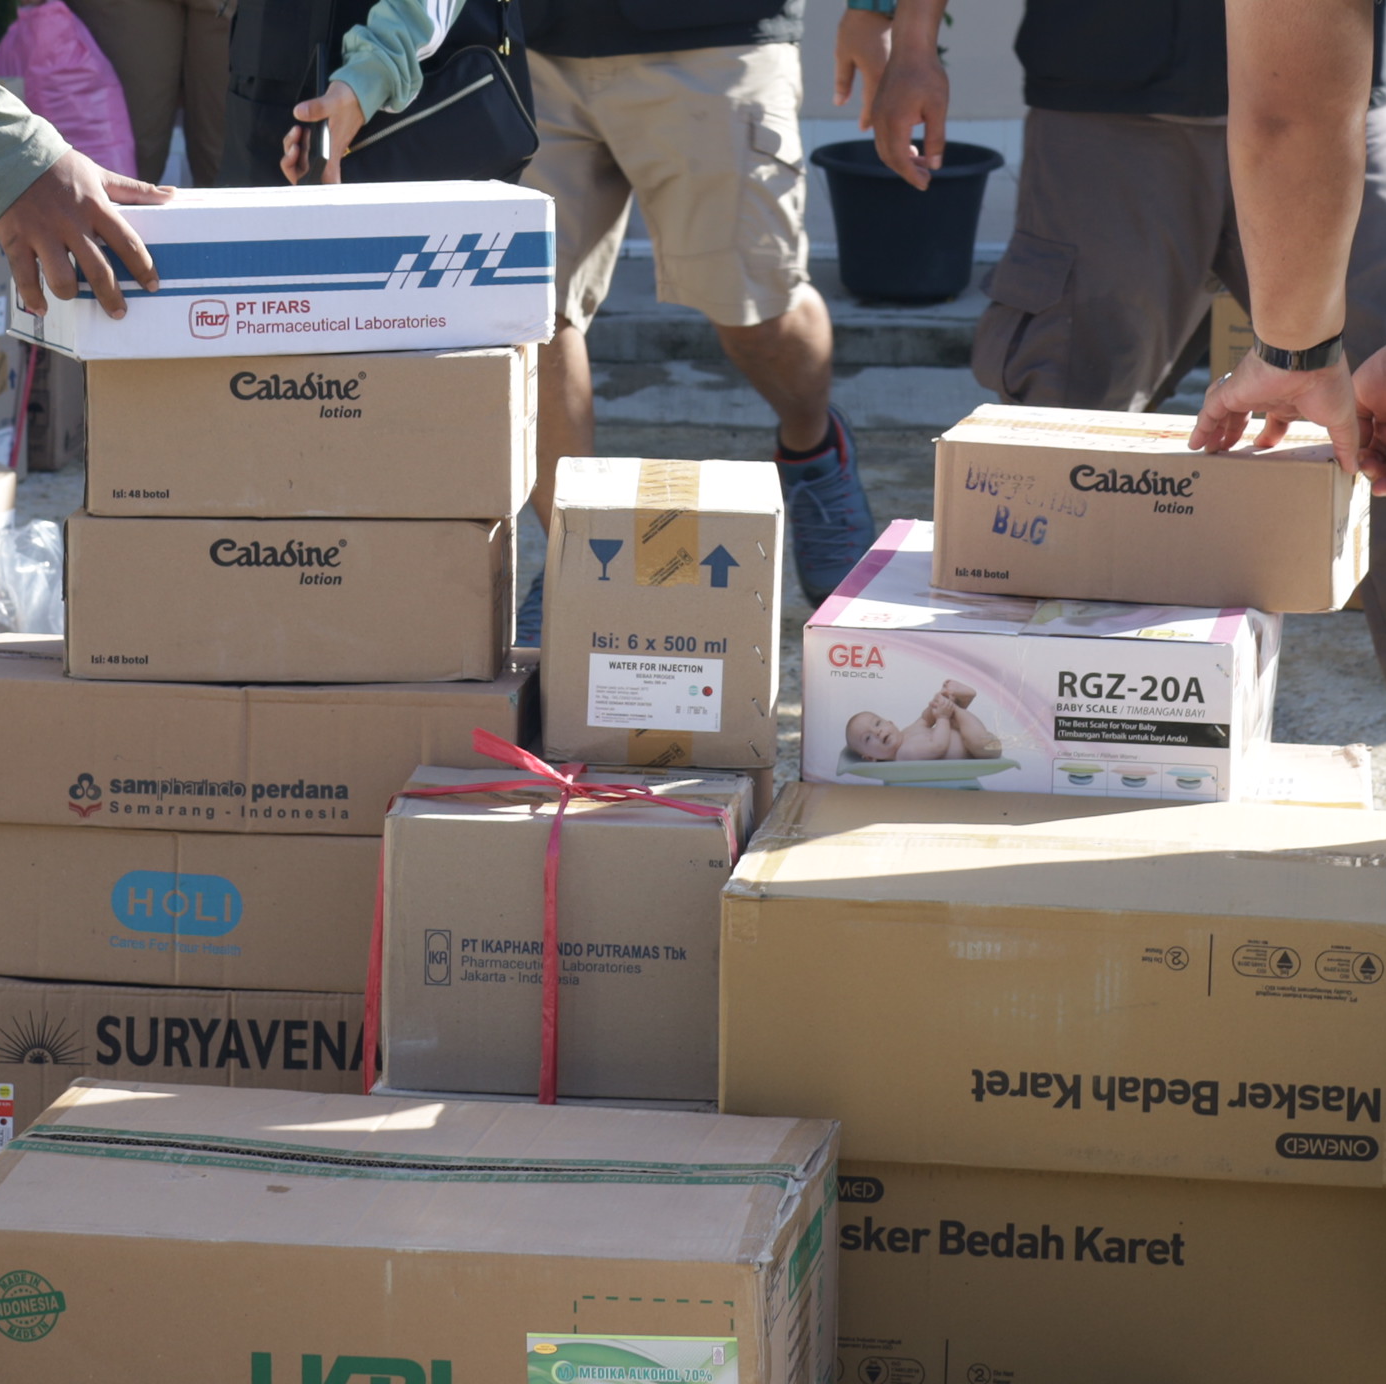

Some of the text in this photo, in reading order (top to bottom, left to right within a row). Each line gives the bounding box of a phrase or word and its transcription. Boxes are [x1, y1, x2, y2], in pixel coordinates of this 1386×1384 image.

[236, 301, 258, 315] PT
[262, 300, 311, 315] IFARS
[236, 314, 447, 335] Pharmaceutical Laboratories
[229, 371, 361, 401] Caladine
[319, 405, 362, 419] lotion
[1069, 463, 1195, 498] Caladine
[112, 488, 170, 500] Isi: 48 botol
[1152, 500, 1194, 516] lotion
[209, 538, 341, 568] Caladine
[299, 572, 343, 586] lotion
[955, 567, 1010, 580] Isi: 48 botol
[592, 632, 728, 654] Isi: 6 x 500 ml
[90, 654, 149, 666] Isi: 48 botol
[828, 643, 884, 668] GEA
[608, 661, 704, 674] WATER FOR INJECTION
[1058, 670, 1206, 704] RGZ-20A
[1056, 703, 1083, 713] BABY
[1086, 704, 1118, 714] SCALE
[1126, 705, 1184, 717] TIMBANGAN
[1184, 708, 1206, 718] BAYI
[1058, 719, 1157, 732] The Best Scale for Your Baby
[1057, 730, 1188, 744] (Timbangan Terbaik untuk bayi Anda)
[250, 778, 350, 803] perdana
[108, 800, 216, 821] Semarang
[240, 805, 350, 821] Indonesia
[127, 886, 233, 923] HOLI
[108, 935, 147, 950] Cares
[148, 937, 170, 952] For
[202, 941, 242, 957] Health
[428, 938, 688, 965] IKA PT IKAPHARNDO PUTRAMAS Tbk
[460, 954, 643, 975] Pharmaceuti Laboratories
[459, 969, 508, 984] Jakarta
[95, 1014, 383, 1073] SURYAVENA
[970, 1068, 1383, 1124] Masker Bedah Karet
[1283, 1137, 1371, 1157] ONEMED
[838, 1180, 877, 1199] MED
[839, 1216, 1186, 1267] sker Bedah Karet
[0, 1273, 41, 1292] MADE IN
[579, 1367, 625, 1380] MEDIKA
[629, 1368, 680, 1381] ALKOHOL
[684, 1369, 713, 1382] 70%
